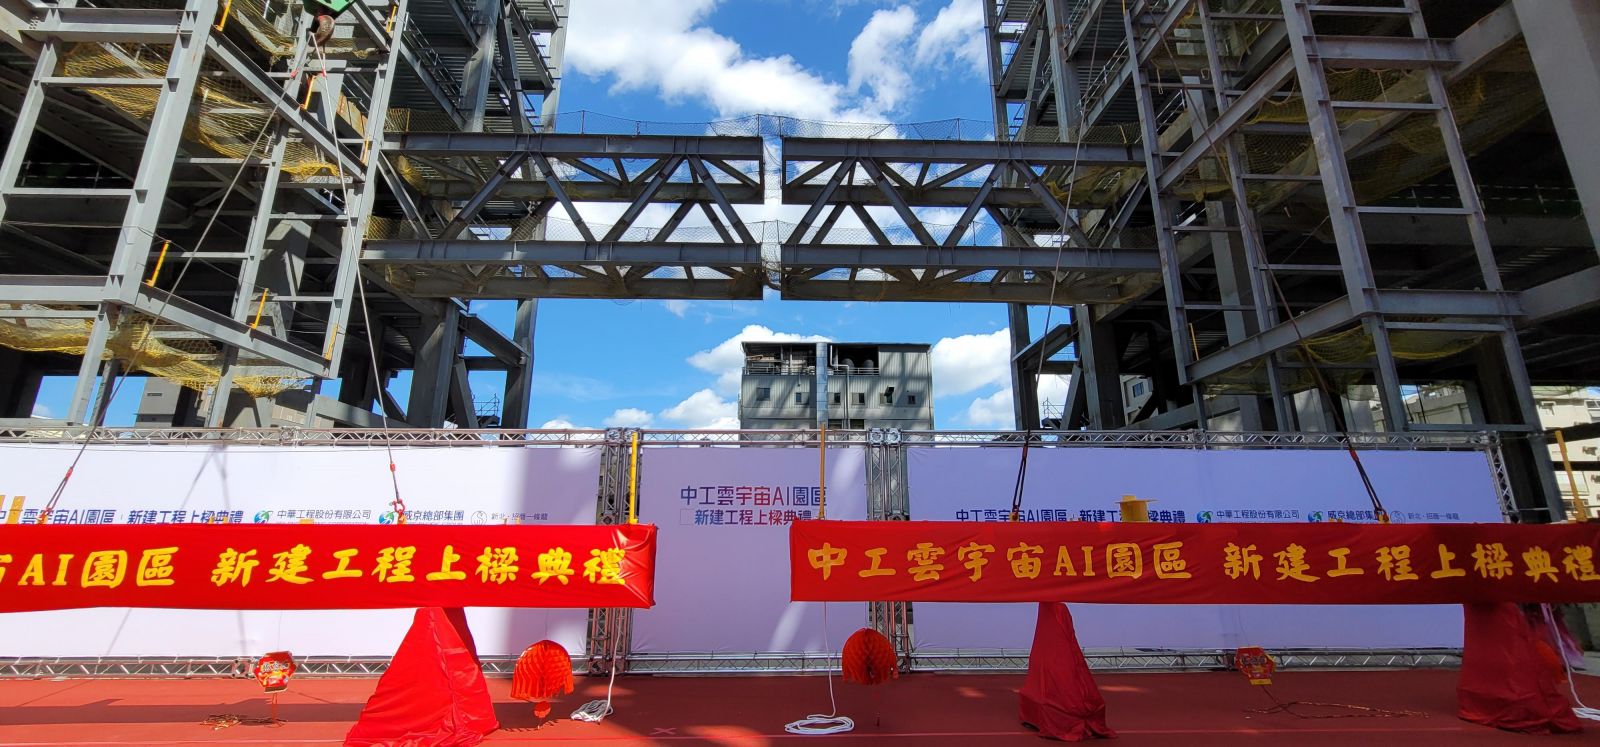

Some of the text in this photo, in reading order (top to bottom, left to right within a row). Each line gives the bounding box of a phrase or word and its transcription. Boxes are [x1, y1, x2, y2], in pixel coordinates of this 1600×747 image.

[681, 485, 827, 507] 中工雲宇宙AI園區
[277, 509, 371, 519] 中華工程股份有限公司
[1080, 509, 1185, 523] 新建工樑典禮
[210, 543, 625, 587] 新建工程上樑典禮
[807, 542, 1600, 583] 中工雲宇宙AI園區 新建工程上樑典禮
